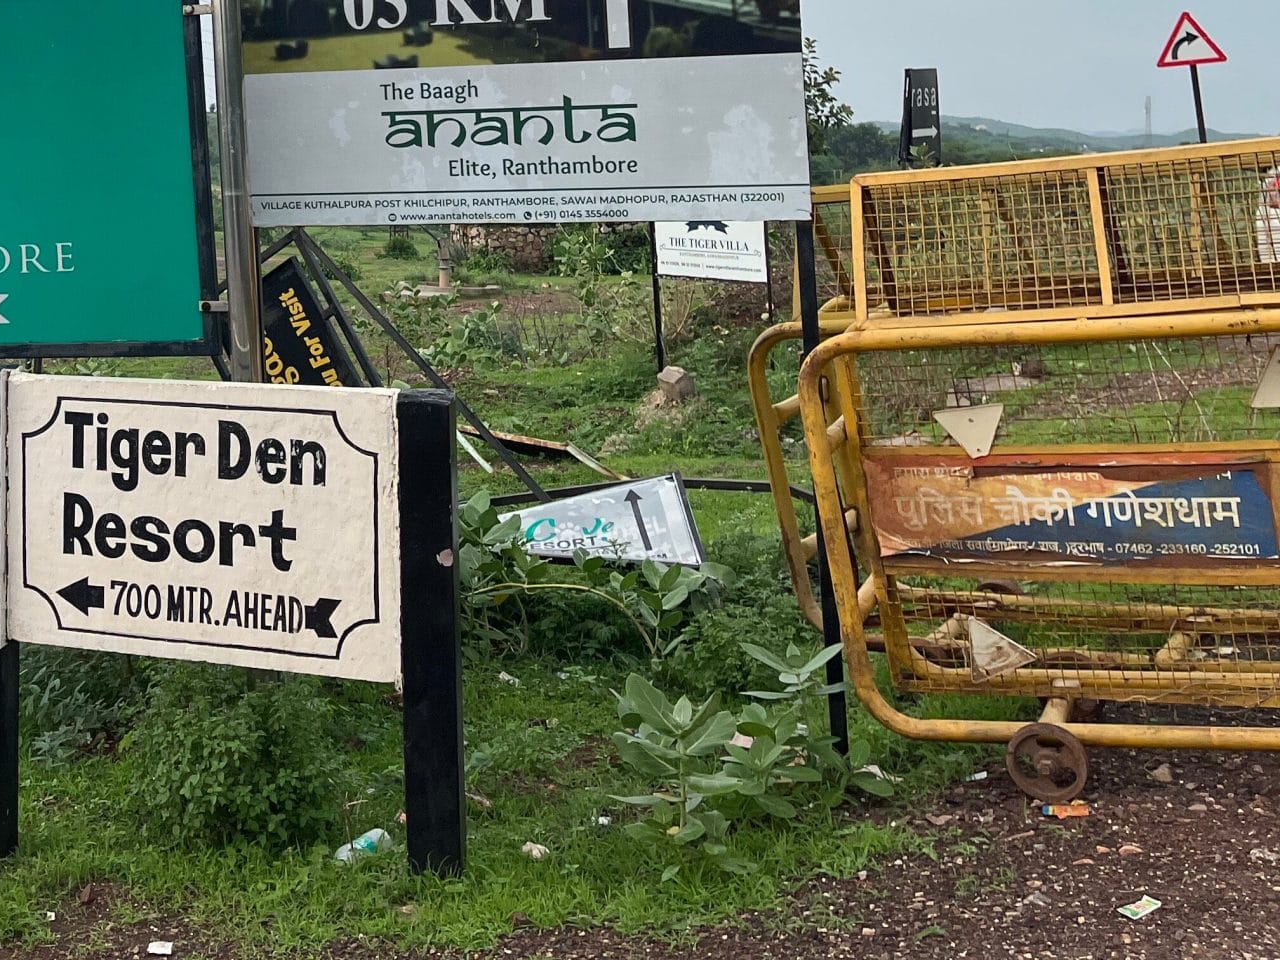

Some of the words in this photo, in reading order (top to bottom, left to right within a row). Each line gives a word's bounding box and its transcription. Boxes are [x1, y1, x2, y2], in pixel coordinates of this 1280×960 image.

[380, 81, 414, 101] The
[420, 79, 479, 103] Baagh
[911, 87, 937, 108] rasa
[381, 94, 638, 148] ananta
[449, 158, 497, 179] Elite,
[503, 155, 638, 176] Ranthambore
[261, 201, 302, 210] VILLAGE
[304, 200, 372, 210] KUTHALPURA
[375, 199, 402, 208] POST
[404, 198, 470, 209] KHILCHIPUR,
[473, 196, 559, 208] RANTHAMBORE,
[561, 196, 596, 205] SAWAI
[599, 194, 668, 205] MADHOPUR,
[671, 193, 737, 203] RAJASTHAN
[740, 192, 785, 203] (322001)
[400, 210, 516, 221] www.anantahotels.com
[534, 209, 557, 220] (+91)
[559, 210, 582, 219] 0145
[584, 209, 629, 219] 3554000
[669, 237, 687, 248] THE
[689, 238, 718, 250] TIGER
[718, 240, 749, 252] VILLA
[279, 287, 311, 337] Visit
[303, 336, 330, 369] For
[64, 411, 206, 492] Tiger
[218, 420, 326, 487] Den
[990, 486, 1076, 527] चौकी
[1083, 487, 1241, 527] गणेशधाम
[62, 492, 297, 572] Resort
[1115, 543, 1153, 554] 07462
[110, 580, 161, 620] 700
[166, 583, 220, 627] MTR.
[224, 589, 303, 634] AHEAD
